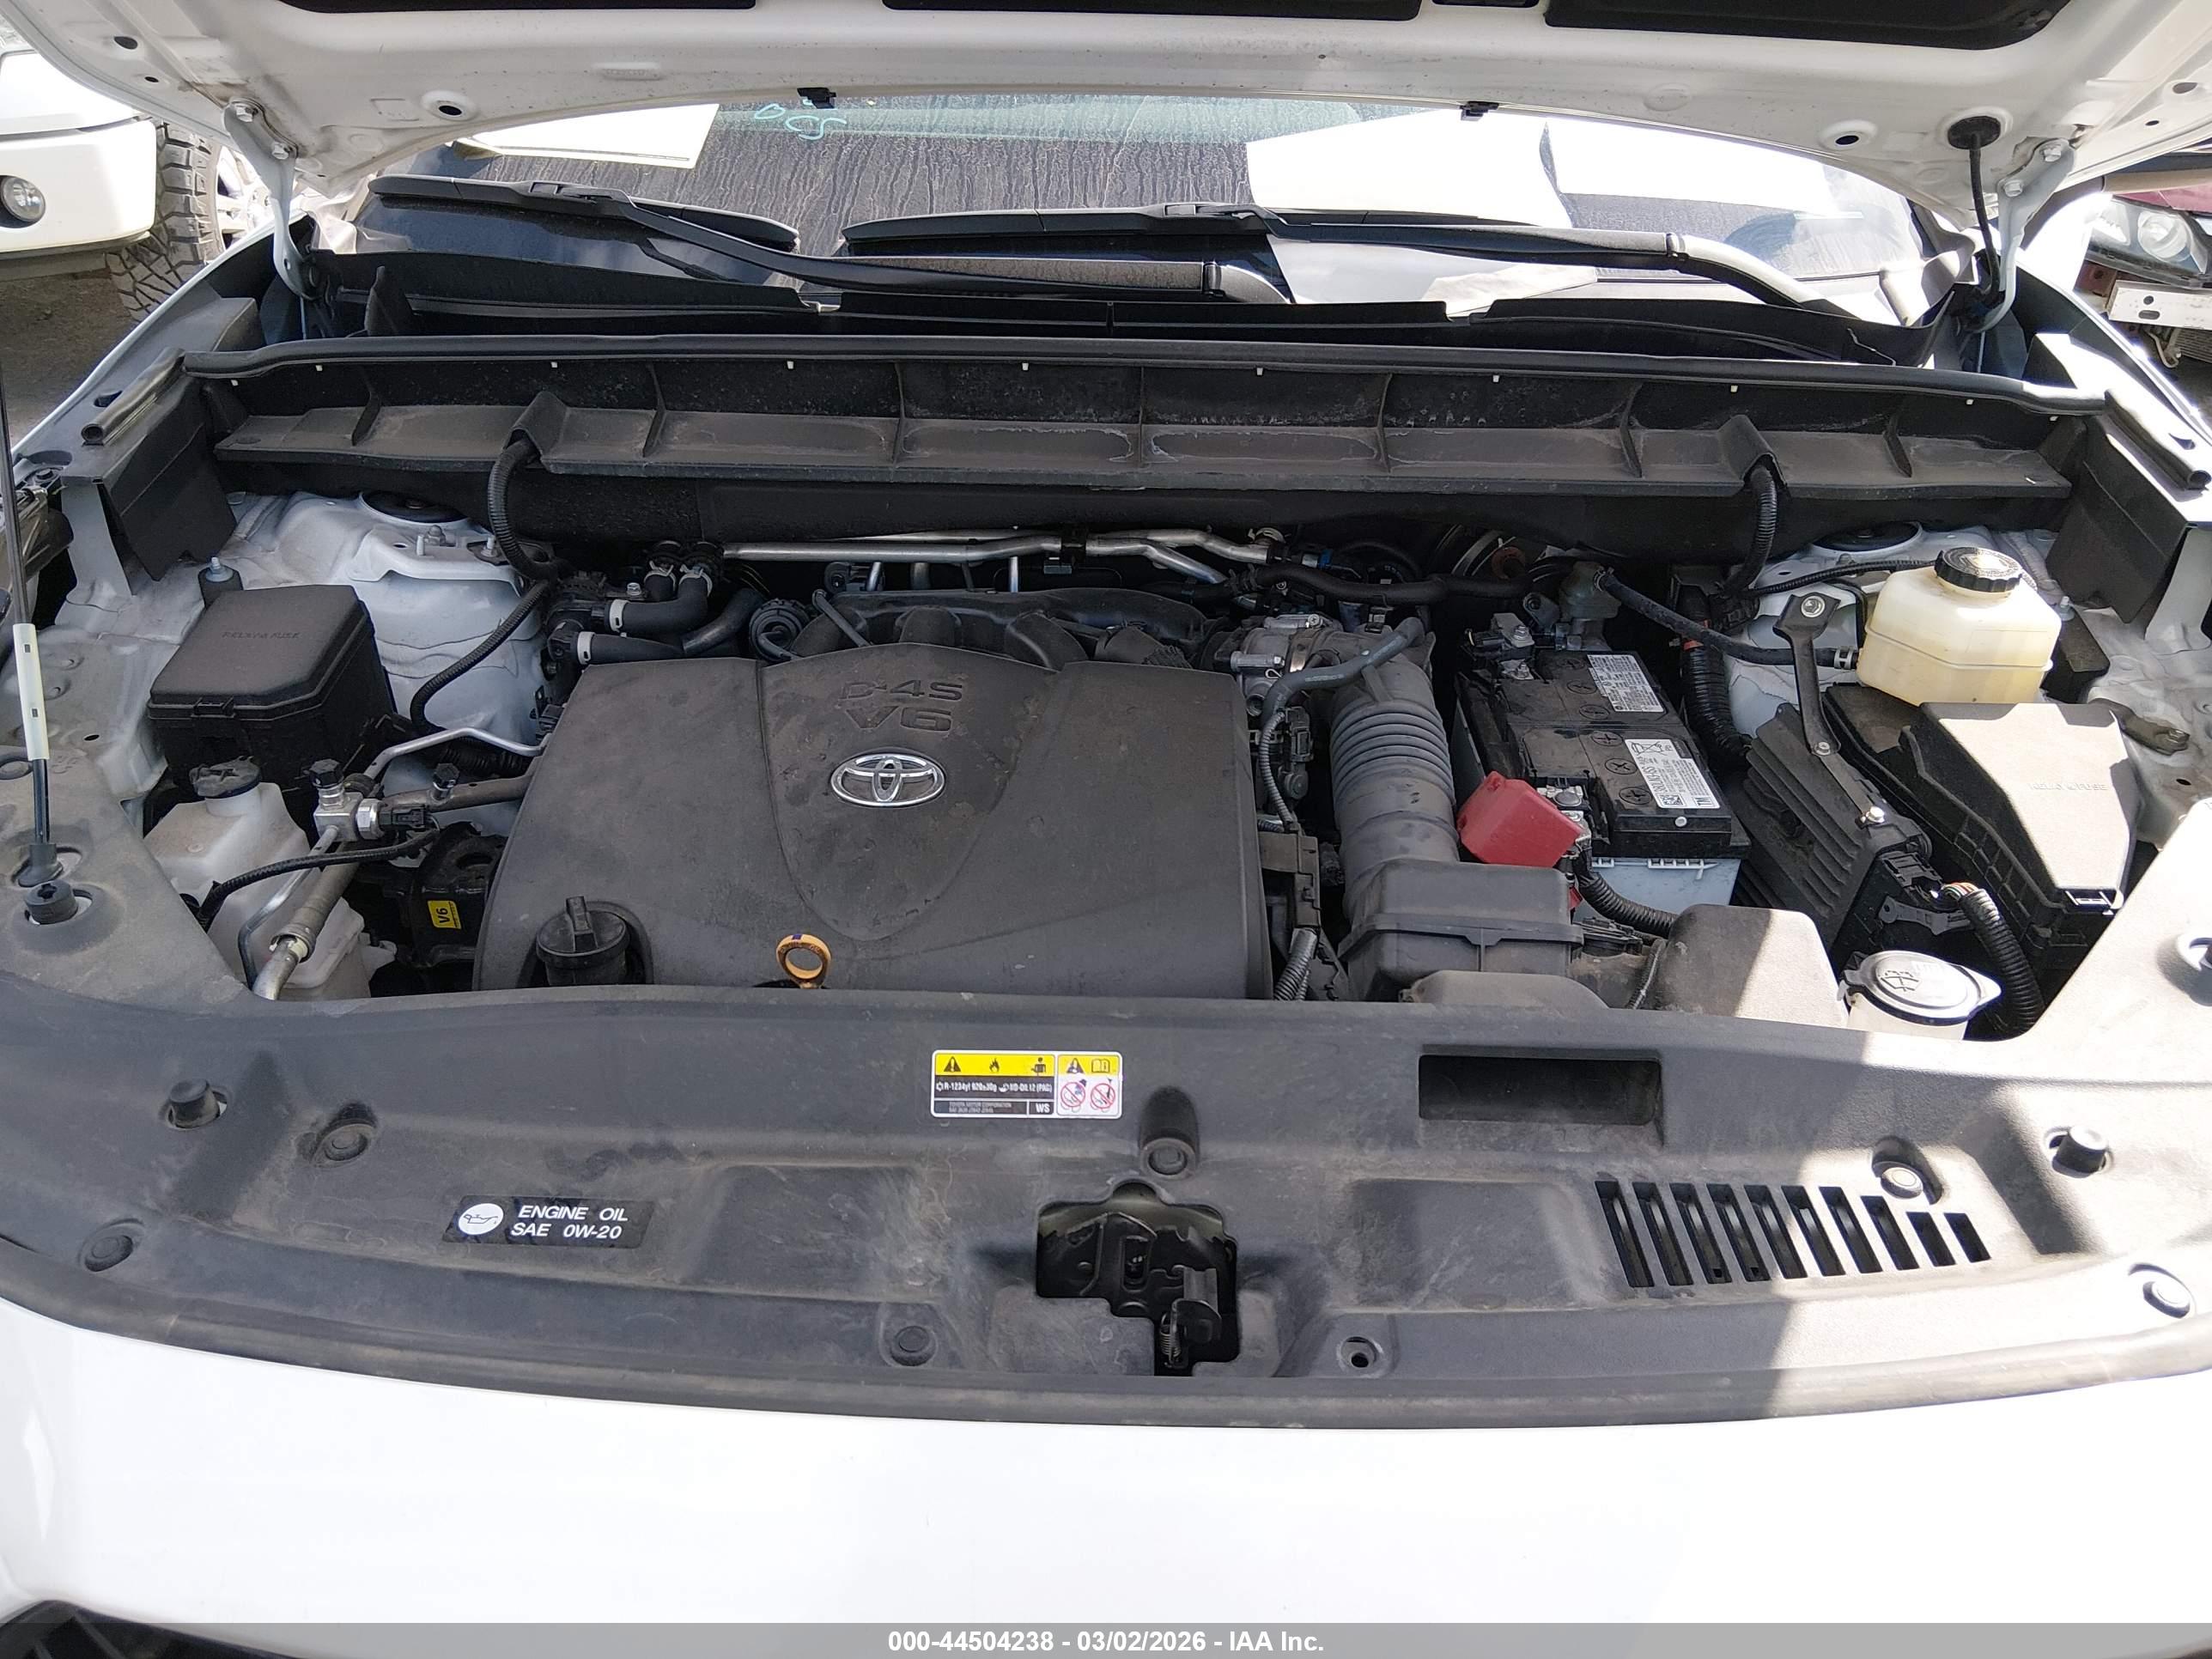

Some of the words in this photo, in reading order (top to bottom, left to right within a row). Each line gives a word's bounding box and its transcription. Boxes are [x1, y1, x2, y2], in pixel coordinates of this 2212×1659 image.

[845, 705, 953, 732] V6
[435, 908, 451, 924] V6
[1036, 1103, 1050, 1114] WS
[518, 1205, 589, 1220] ENGINE
[599, 1207, 629, 1222] OIL
[510, 1222, 551, 1237] SAE
[562, 1224, 623, 1239] 0W-20
